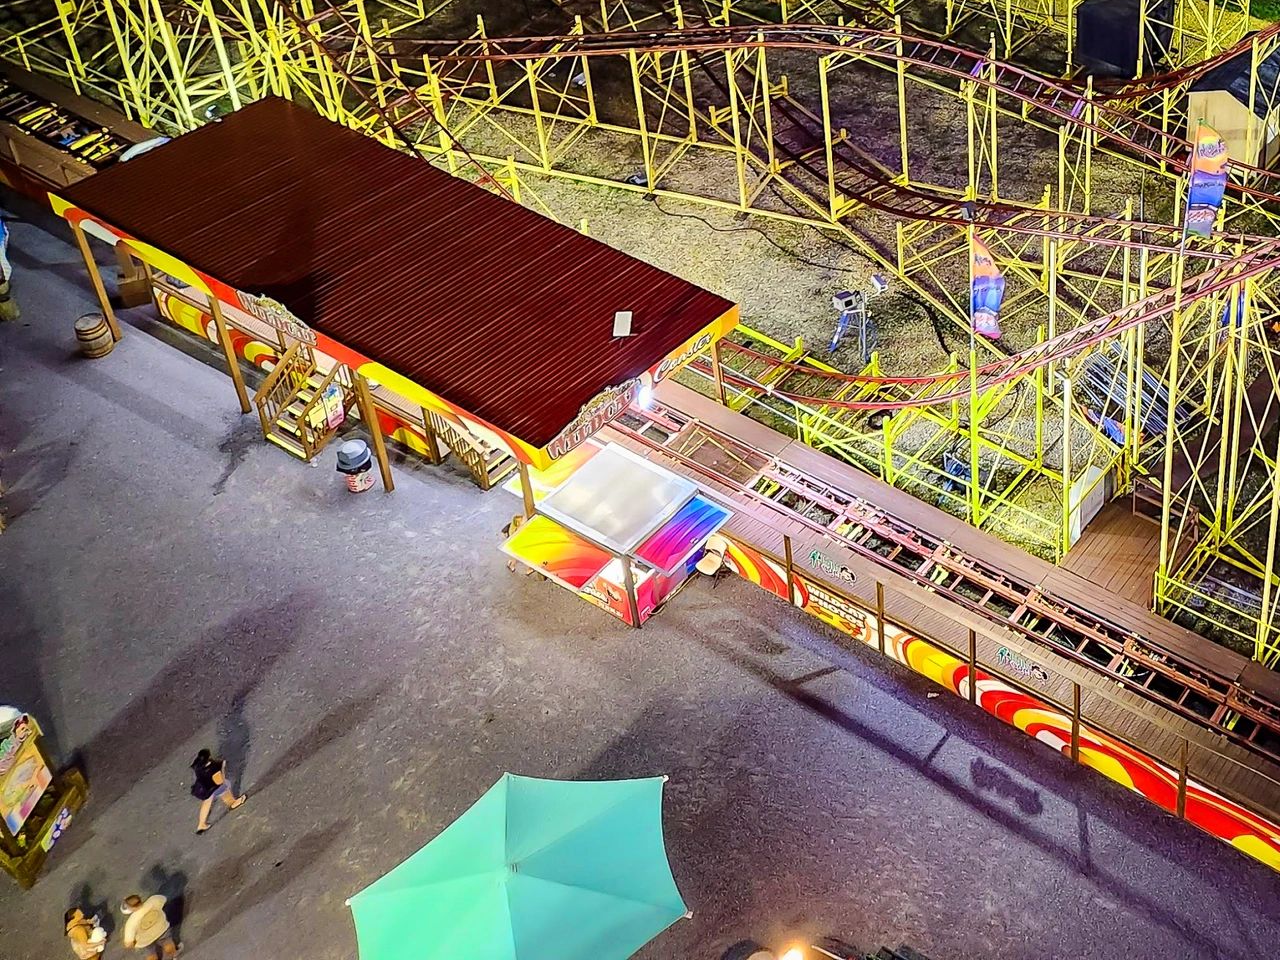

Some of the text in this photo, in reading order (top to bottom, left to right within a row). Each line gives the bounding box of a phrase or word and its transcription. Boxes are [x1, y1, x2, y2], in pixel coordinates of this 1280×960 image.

[654, 333, 715, 382] Coaster
[806, 584, 866, 620] WILDCAT
[808, 592, 866, 629] PHOTOS
